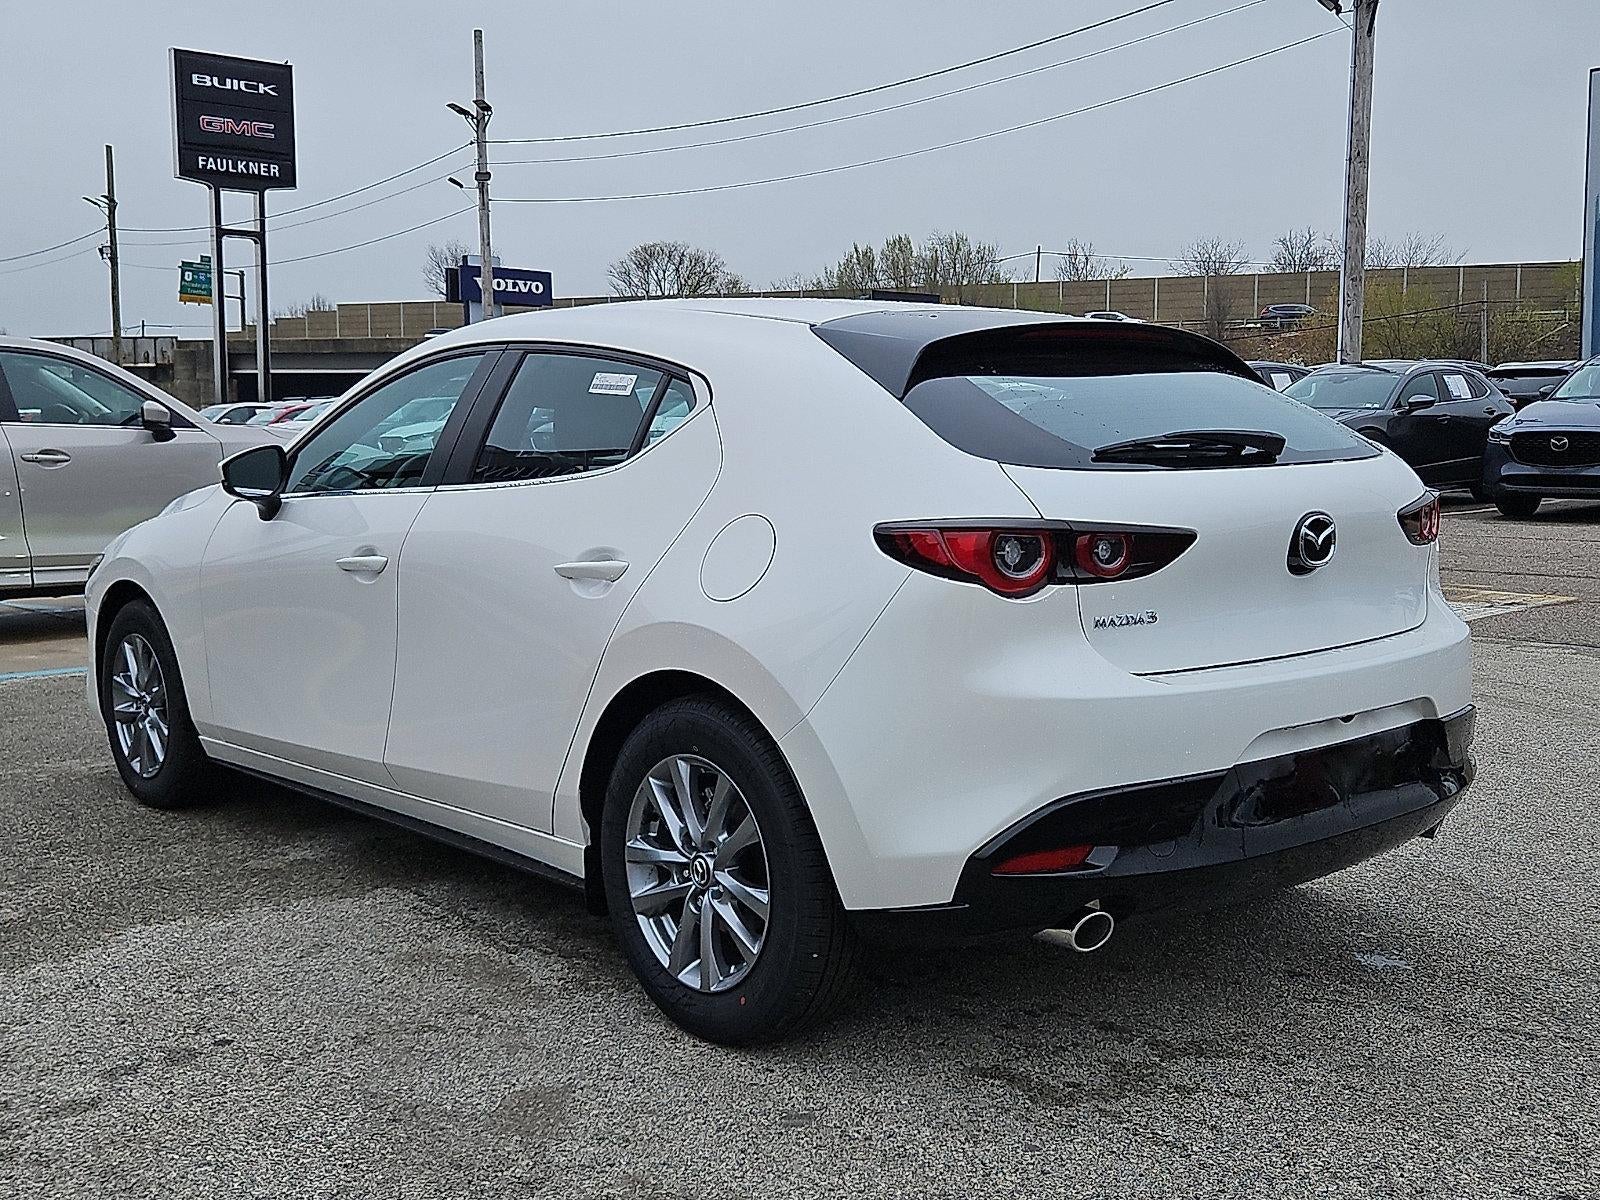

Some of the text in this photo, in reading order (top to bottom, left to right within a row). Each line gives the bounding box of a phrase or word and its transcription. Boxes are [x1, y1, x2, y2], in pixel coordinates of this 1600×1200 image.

[191, 73, 279, 97] BUICK
[199, 115, 275, 139] GMC
[198, 156, 280, 178] FAULKNER
[472, 276, 544, 295] VOLVO
